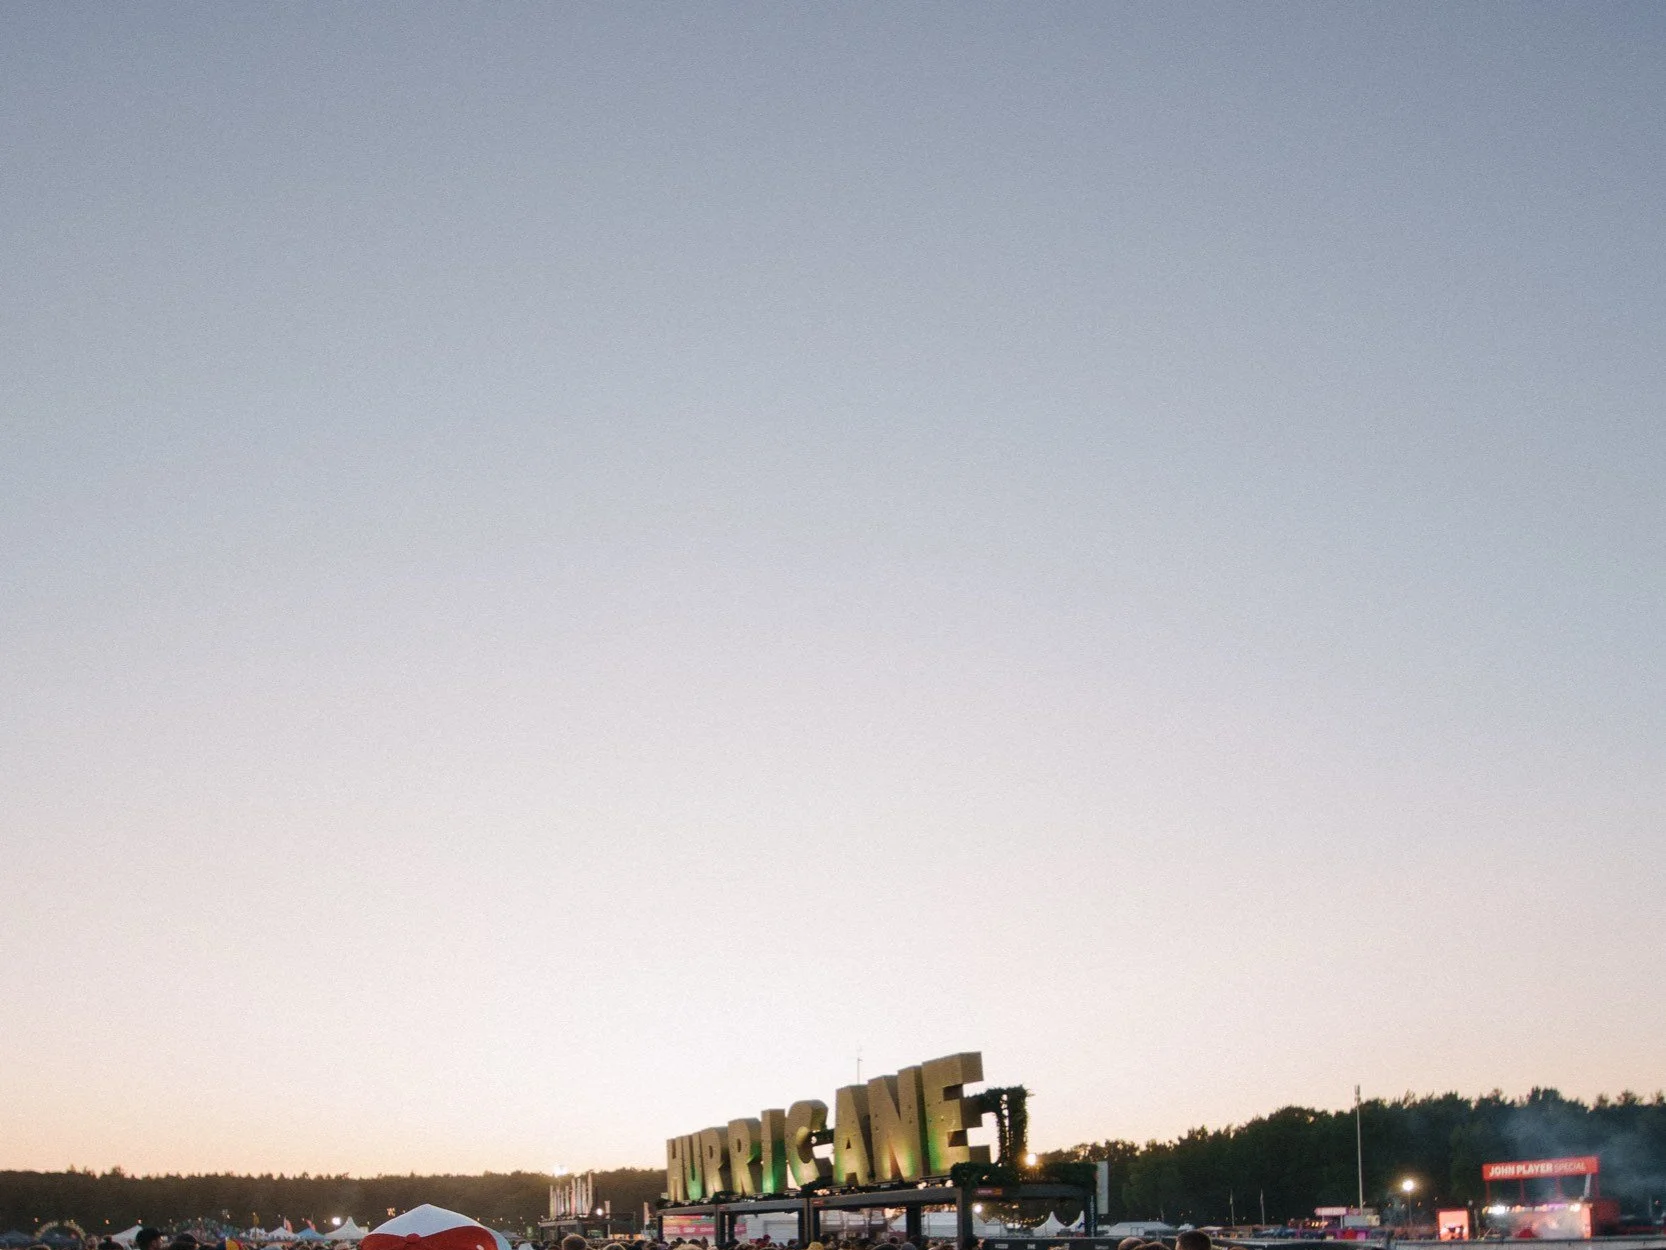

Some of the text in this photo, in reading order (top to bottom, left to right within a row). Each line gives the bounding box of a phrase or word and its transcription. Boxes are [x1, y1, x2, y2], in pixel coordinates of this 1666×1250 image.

[666, 1051, 991, 1201] HURRICANE
[1489, 1161, 1586, 1177] JOHN PLAYER SPECIAL
